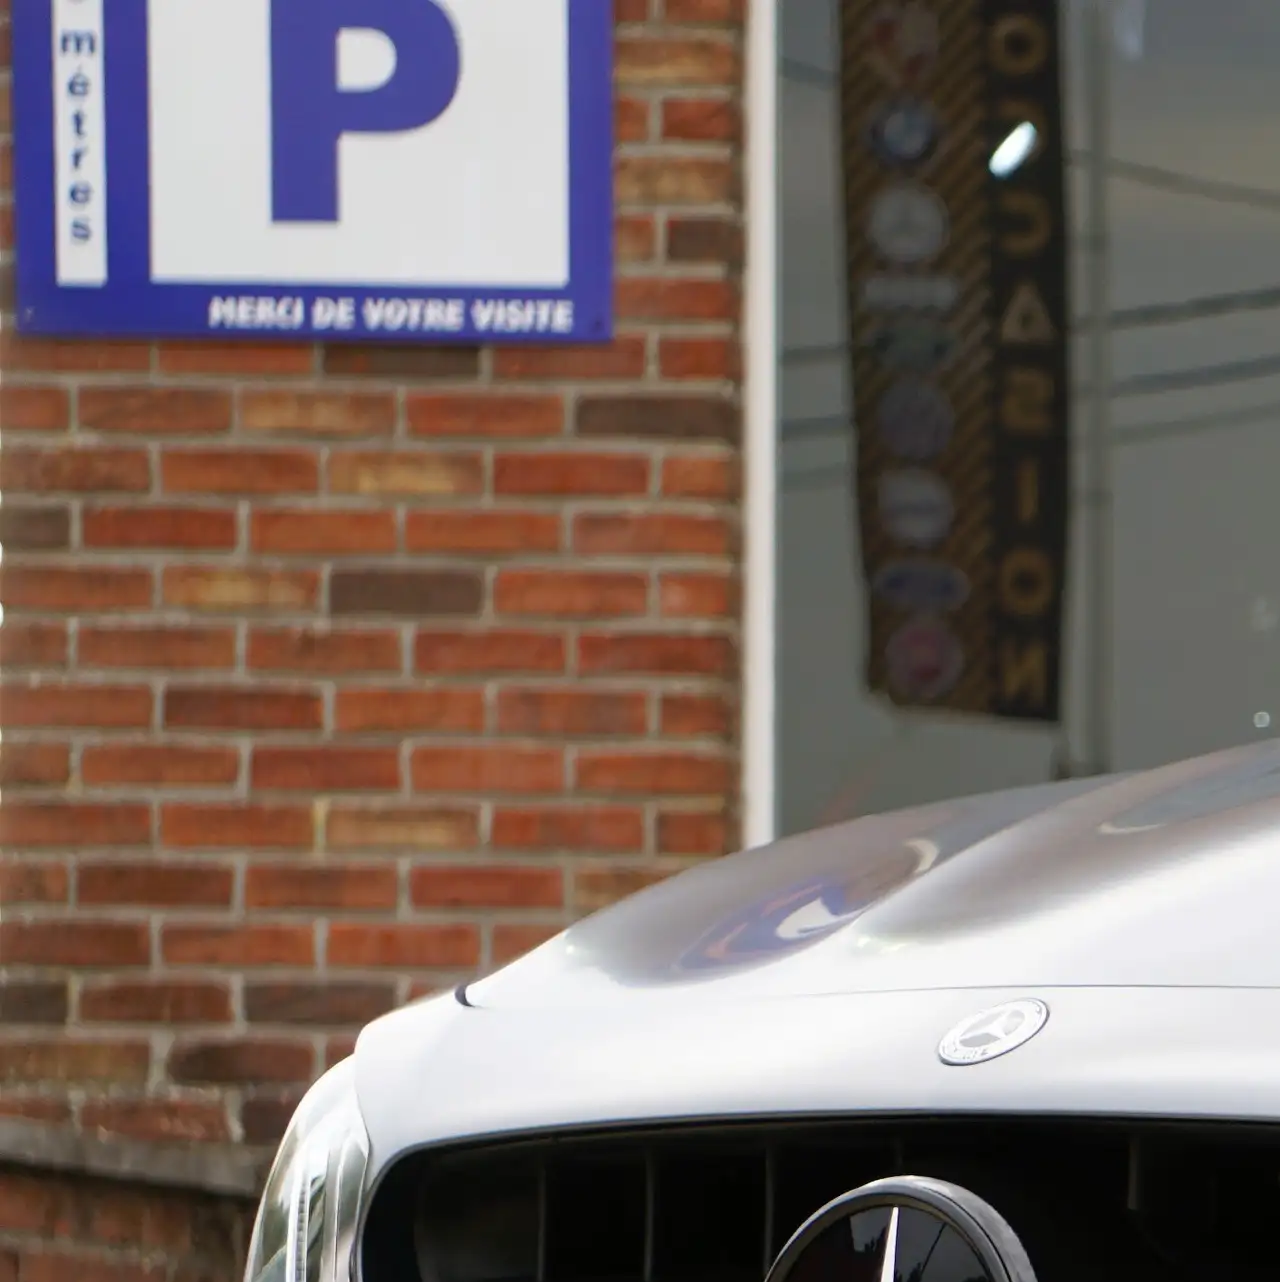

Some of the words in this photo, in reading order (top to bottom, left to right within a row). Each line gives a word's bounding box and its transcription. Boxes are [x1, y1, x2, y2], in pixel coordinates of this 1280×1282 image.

[270, 0, 461, 222] P
[208, 295, 305, 331] MERCI
[311, 296, 355, 331] DE
[361, 297, 465, 333] VOTRE
[470, 298, 574, 333] VISITE
